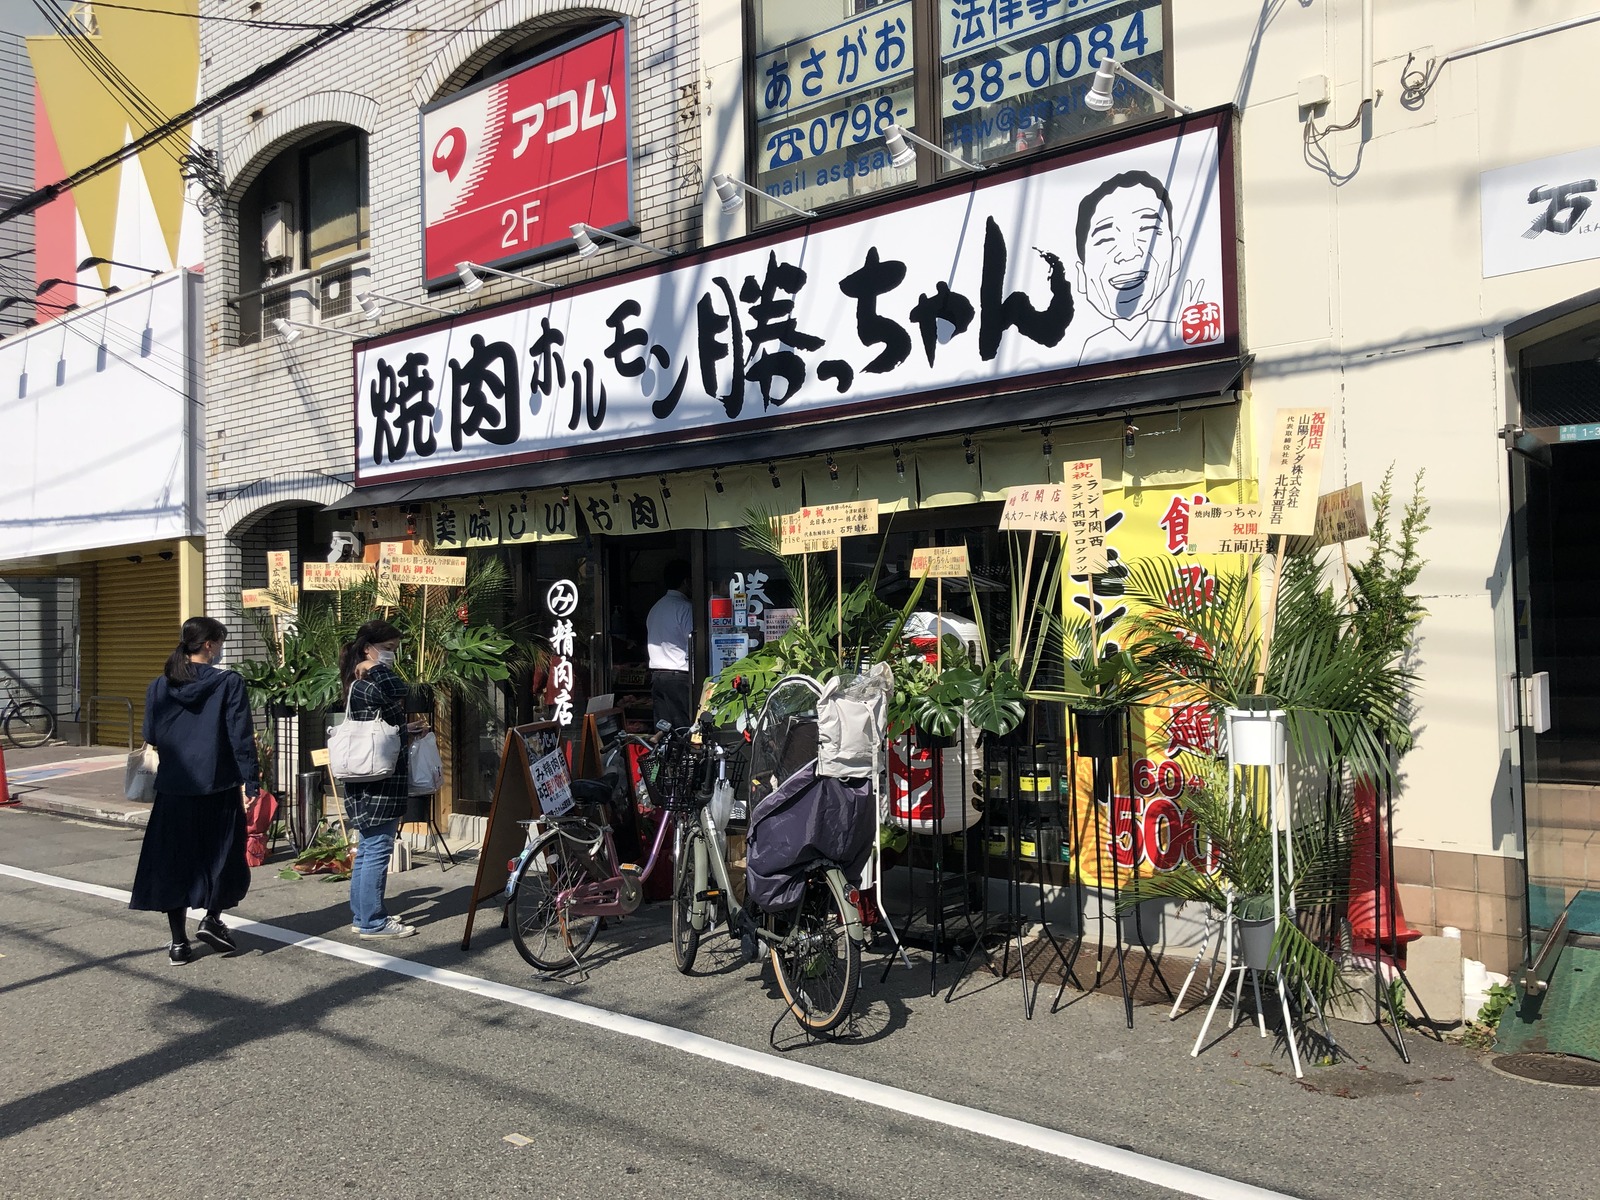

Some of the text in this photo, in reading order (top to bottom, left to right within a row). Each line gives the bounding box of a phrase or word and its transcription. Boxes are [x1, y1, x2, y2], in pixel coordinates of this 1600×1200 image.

[764, 0, 1090, 109] あさがお 法律
[952, 11, 1148, 111] 38-0084
[512, 79, 616, 159] アコム
[765, 170, 805, 197] mail
[501, 200, 540, 248] 2F
[1307, 412, 1325, 449] 祝開店
[1072, 462, 1094, 480] 御祝
[1270, 416, 1295, 524] 代表取締役社長 北村晋吾
[1287, 414, 1310, 508] 山陽イシダ株式会社
[436, 492, 659, 545] 美味しいお肉
[1087, 480, 1104, 547] ラジオ関西
[1194, 507, 1263, 518] 焼肉勝っちゃ
[1233, 523, 1260, 535] 祝開
